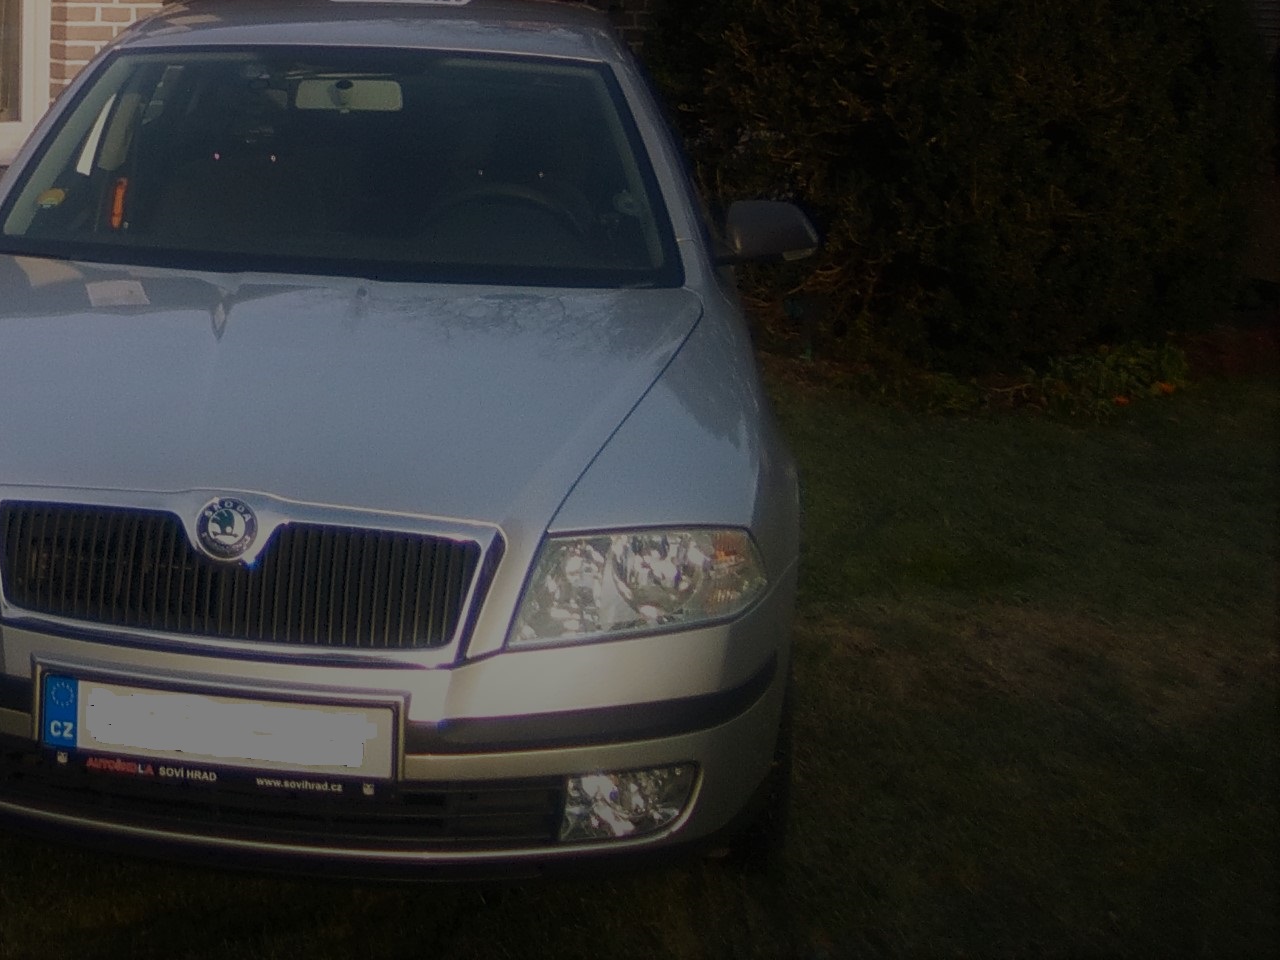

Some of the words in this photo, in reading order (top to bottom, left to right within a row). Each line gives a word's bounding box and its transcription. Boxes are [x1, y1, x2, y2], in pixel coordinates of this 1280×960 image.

[50, 720, 74, 738] CZ
[187, 770, 217, 782] HRAD
[256, 778, 343, 792] www.sovihrad.cz
